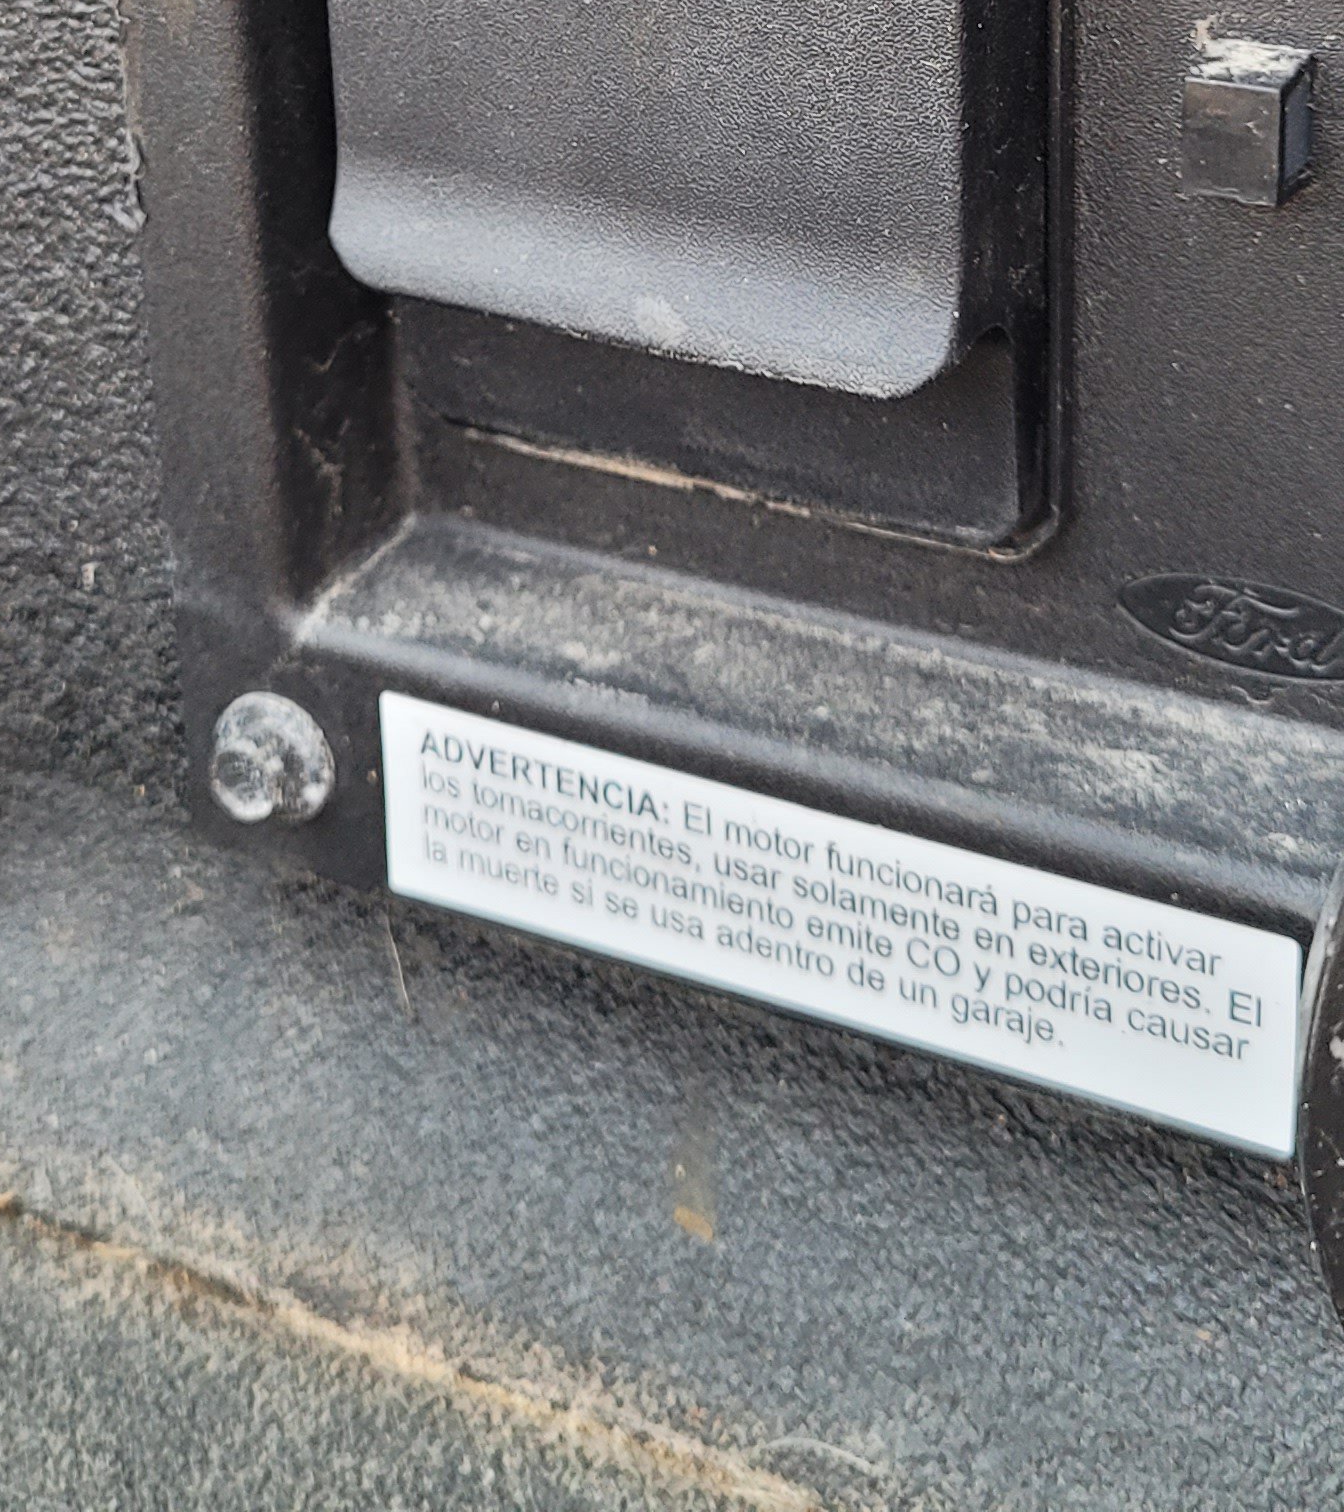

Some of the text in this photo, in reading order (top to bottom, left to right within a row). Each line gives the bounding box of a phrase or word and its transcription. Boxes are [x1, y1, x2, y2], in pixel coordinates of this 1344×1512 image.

[419, 729, 1224, 978] ADVERTENCIA: El motor funcionará para activar
[421, 764, 1263, 1029] los tomacorrientes, usar solamente en exteriores. El
[423, 805, 1251, 1061] motor en funcionamiento emite CO y podría causar
[424, 834, 1064, 1047] la muerte si se usa adentro de un garaje.
